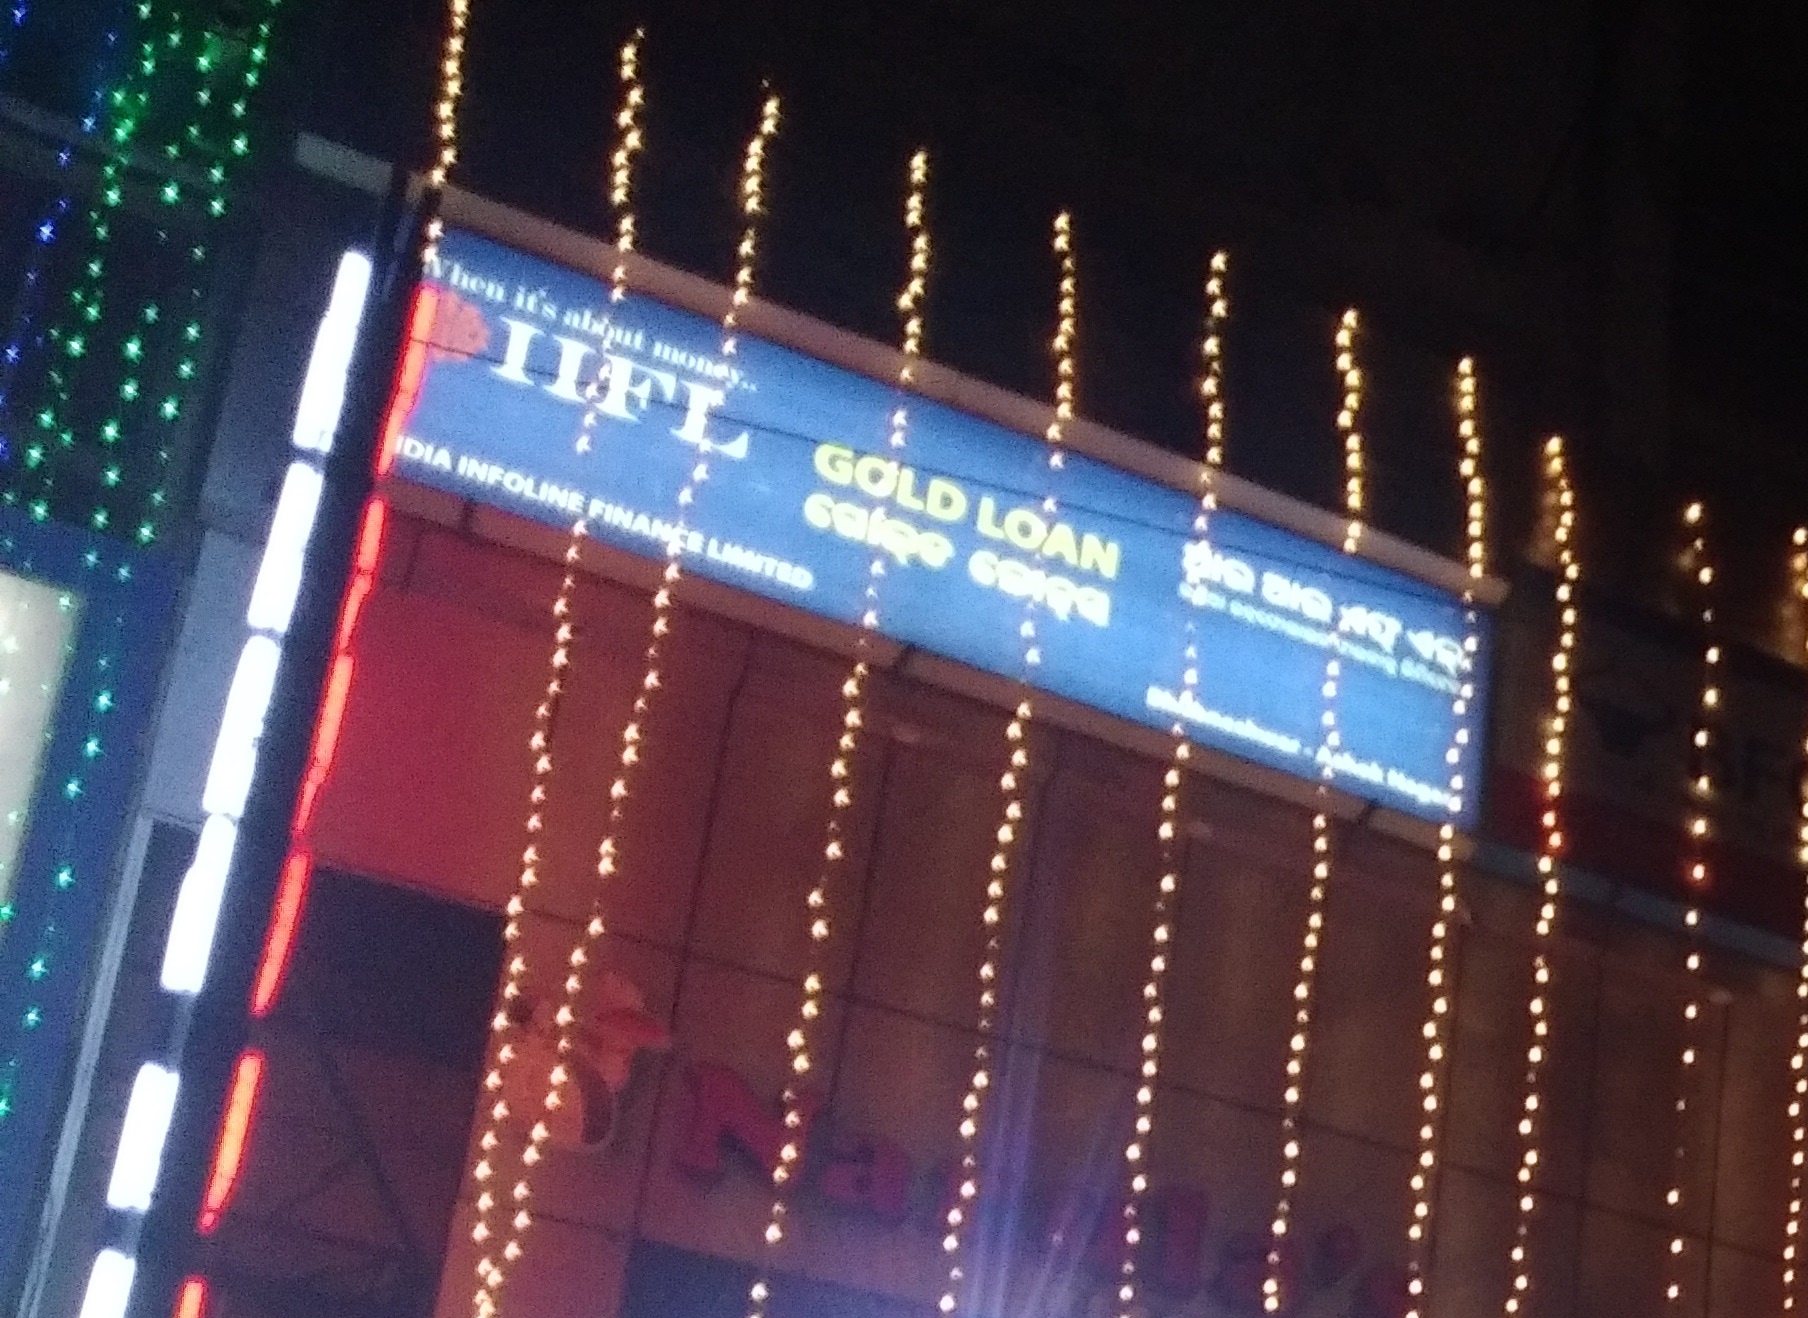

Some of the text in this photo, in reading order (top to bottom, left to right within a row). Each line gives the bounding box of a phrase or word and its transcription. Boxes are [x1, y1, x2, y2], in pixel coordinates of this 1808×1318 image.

[489, 316, 749, 459] IIFL
[514, 286, 557, 320] it's
[563, 308, 644, 350] about
[396, 435, 814, 590] DIA INFOLINE FINANCE LIMITED
[814, 443, 1118, 579] GOLD LOAN
